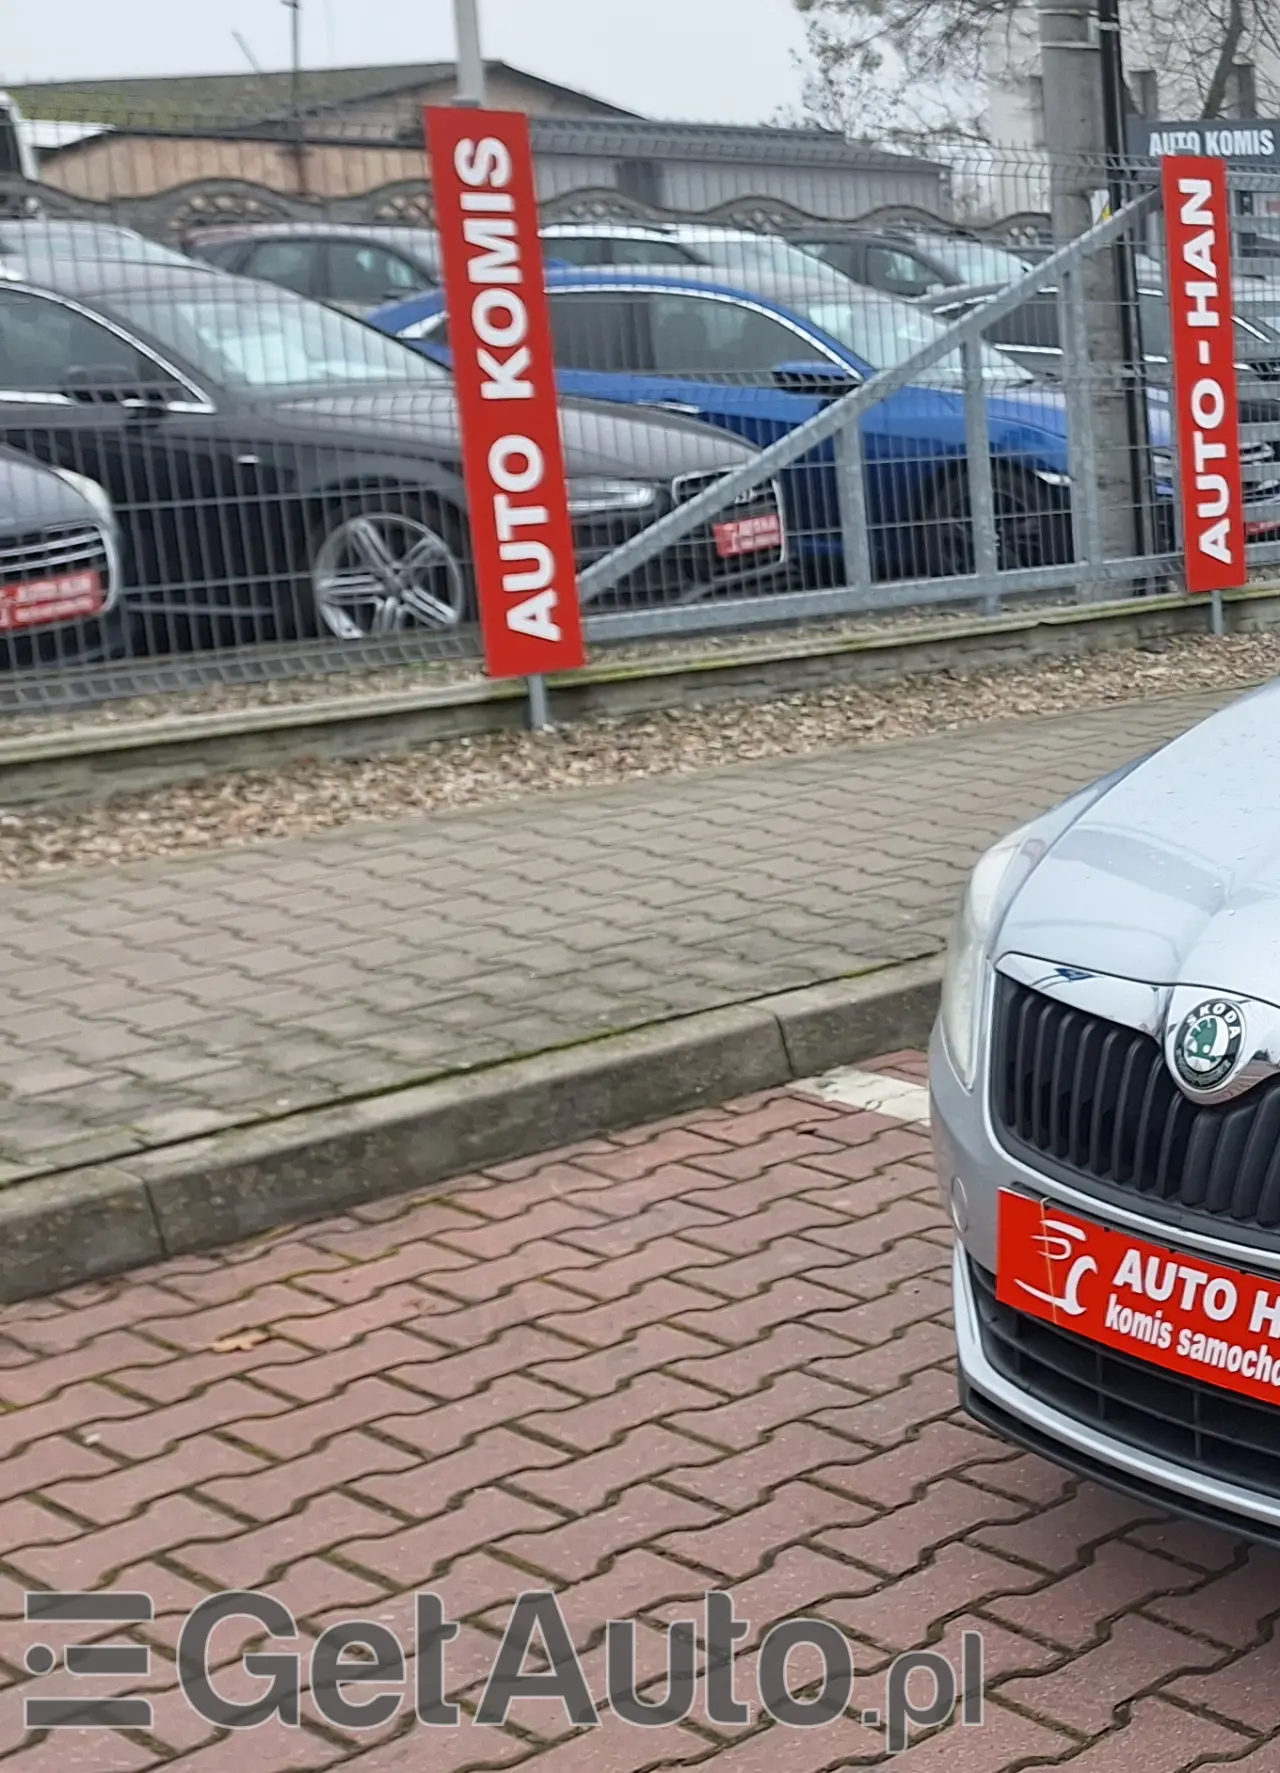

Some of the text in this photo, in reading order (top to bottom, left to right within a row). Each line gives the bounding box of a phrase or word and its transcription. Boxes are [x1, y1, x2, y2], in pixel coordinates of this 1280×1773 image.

[1149, 131, 1200, 156] AUTO
[1205, 129, 1275, 156] KOMIS
[453, 136, 562, 643] AUTO KOMIS
[1112, 1248, 1238, 1322] AUTO
[1104, 1293, 1174, 1350] komis
